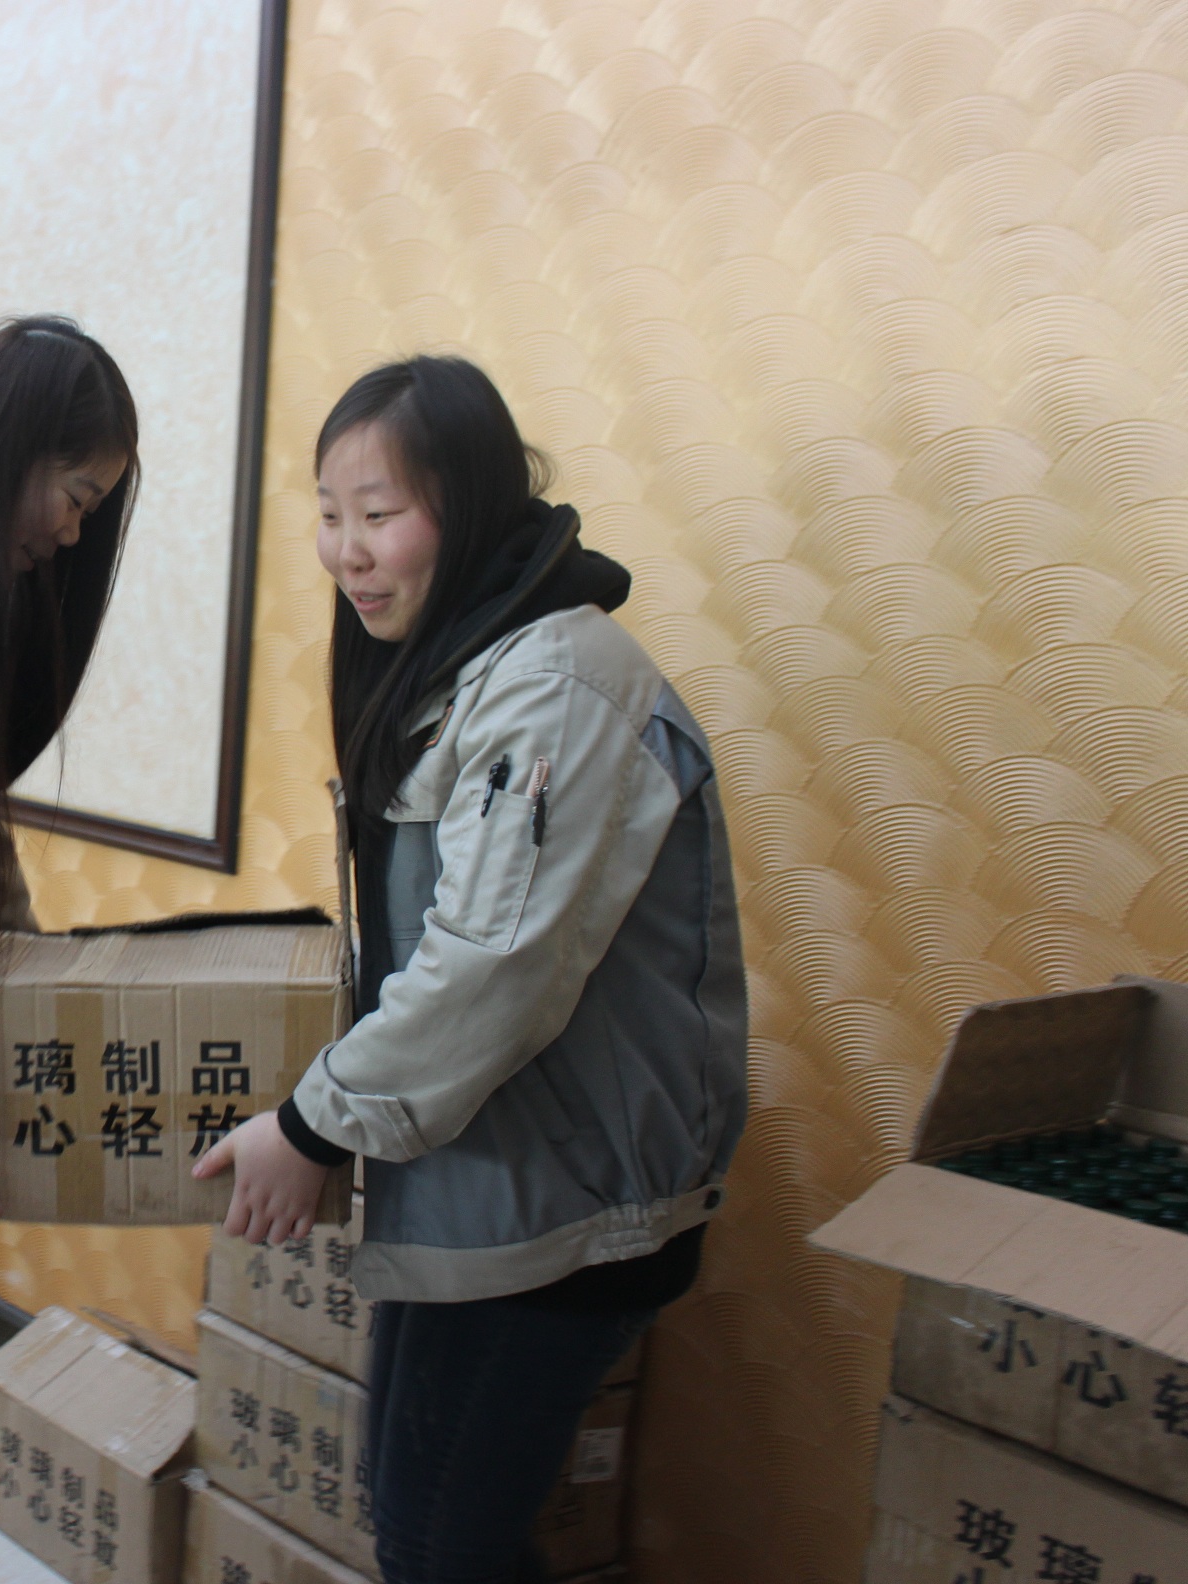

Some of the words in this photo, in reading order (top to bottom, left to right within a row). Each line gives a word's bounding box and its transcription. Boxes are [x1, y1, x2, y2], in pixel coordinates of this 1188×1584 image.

[245, 1251, 377, 1339] 小心轻
[954, 1498, 1155, 1584] 玻璃
